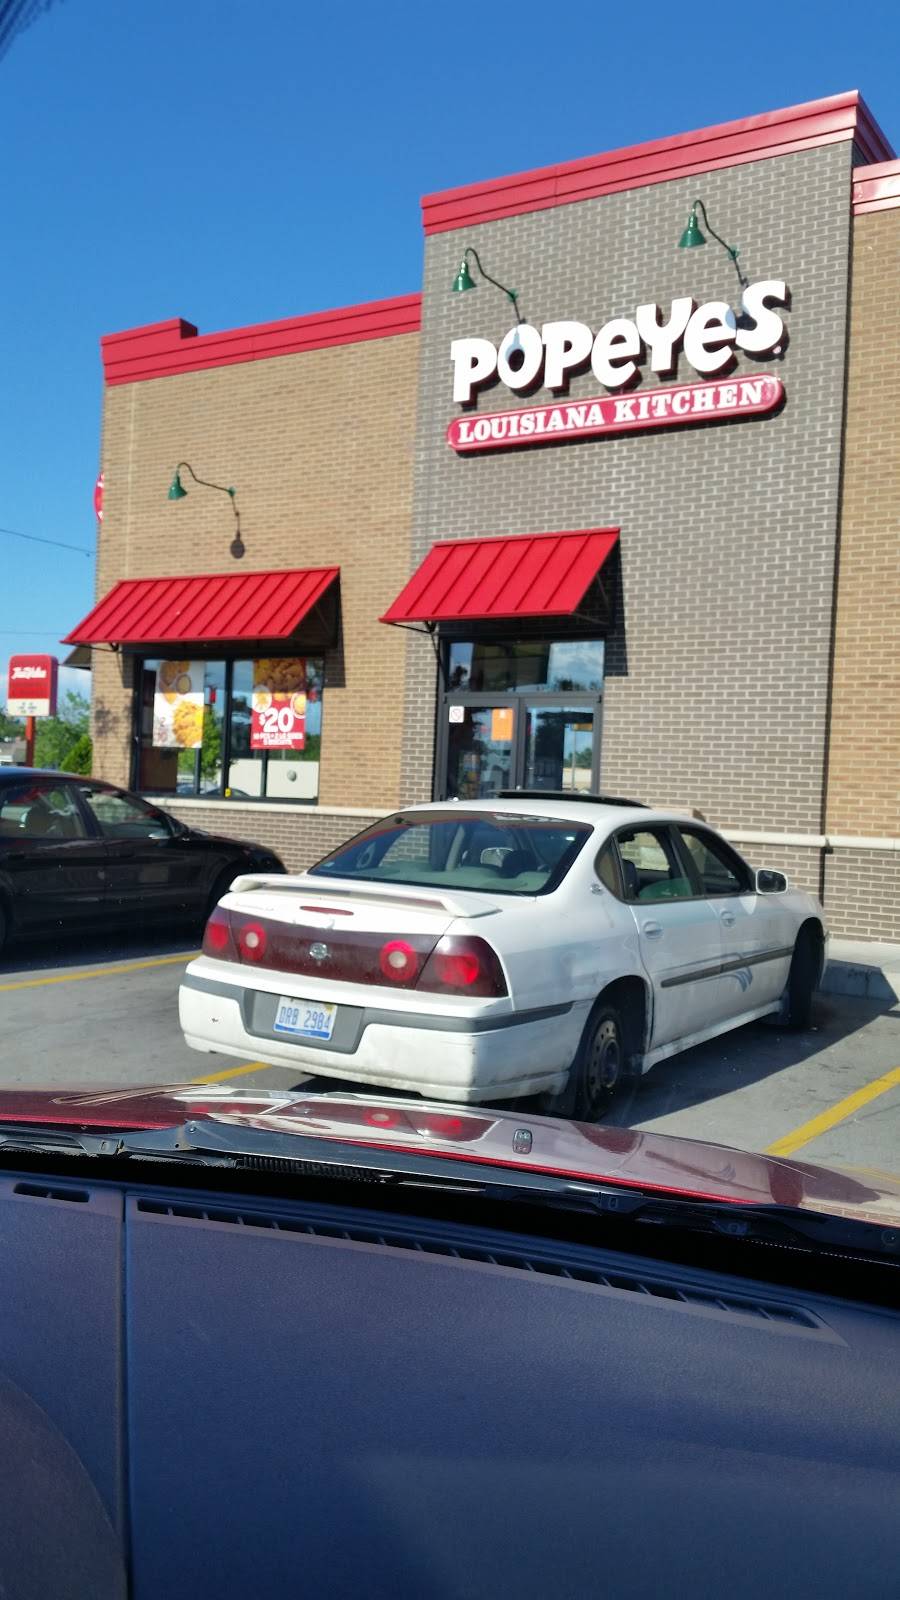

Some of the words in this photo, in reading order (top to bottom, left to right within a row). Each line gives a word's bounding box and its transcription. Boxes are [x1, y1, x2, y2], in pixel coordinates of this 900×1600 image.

[457, 404, 605, 443] LOUISIANA
[612, 381, 765, 422] KITCHEN
[258, 707, 294, 733] $20
